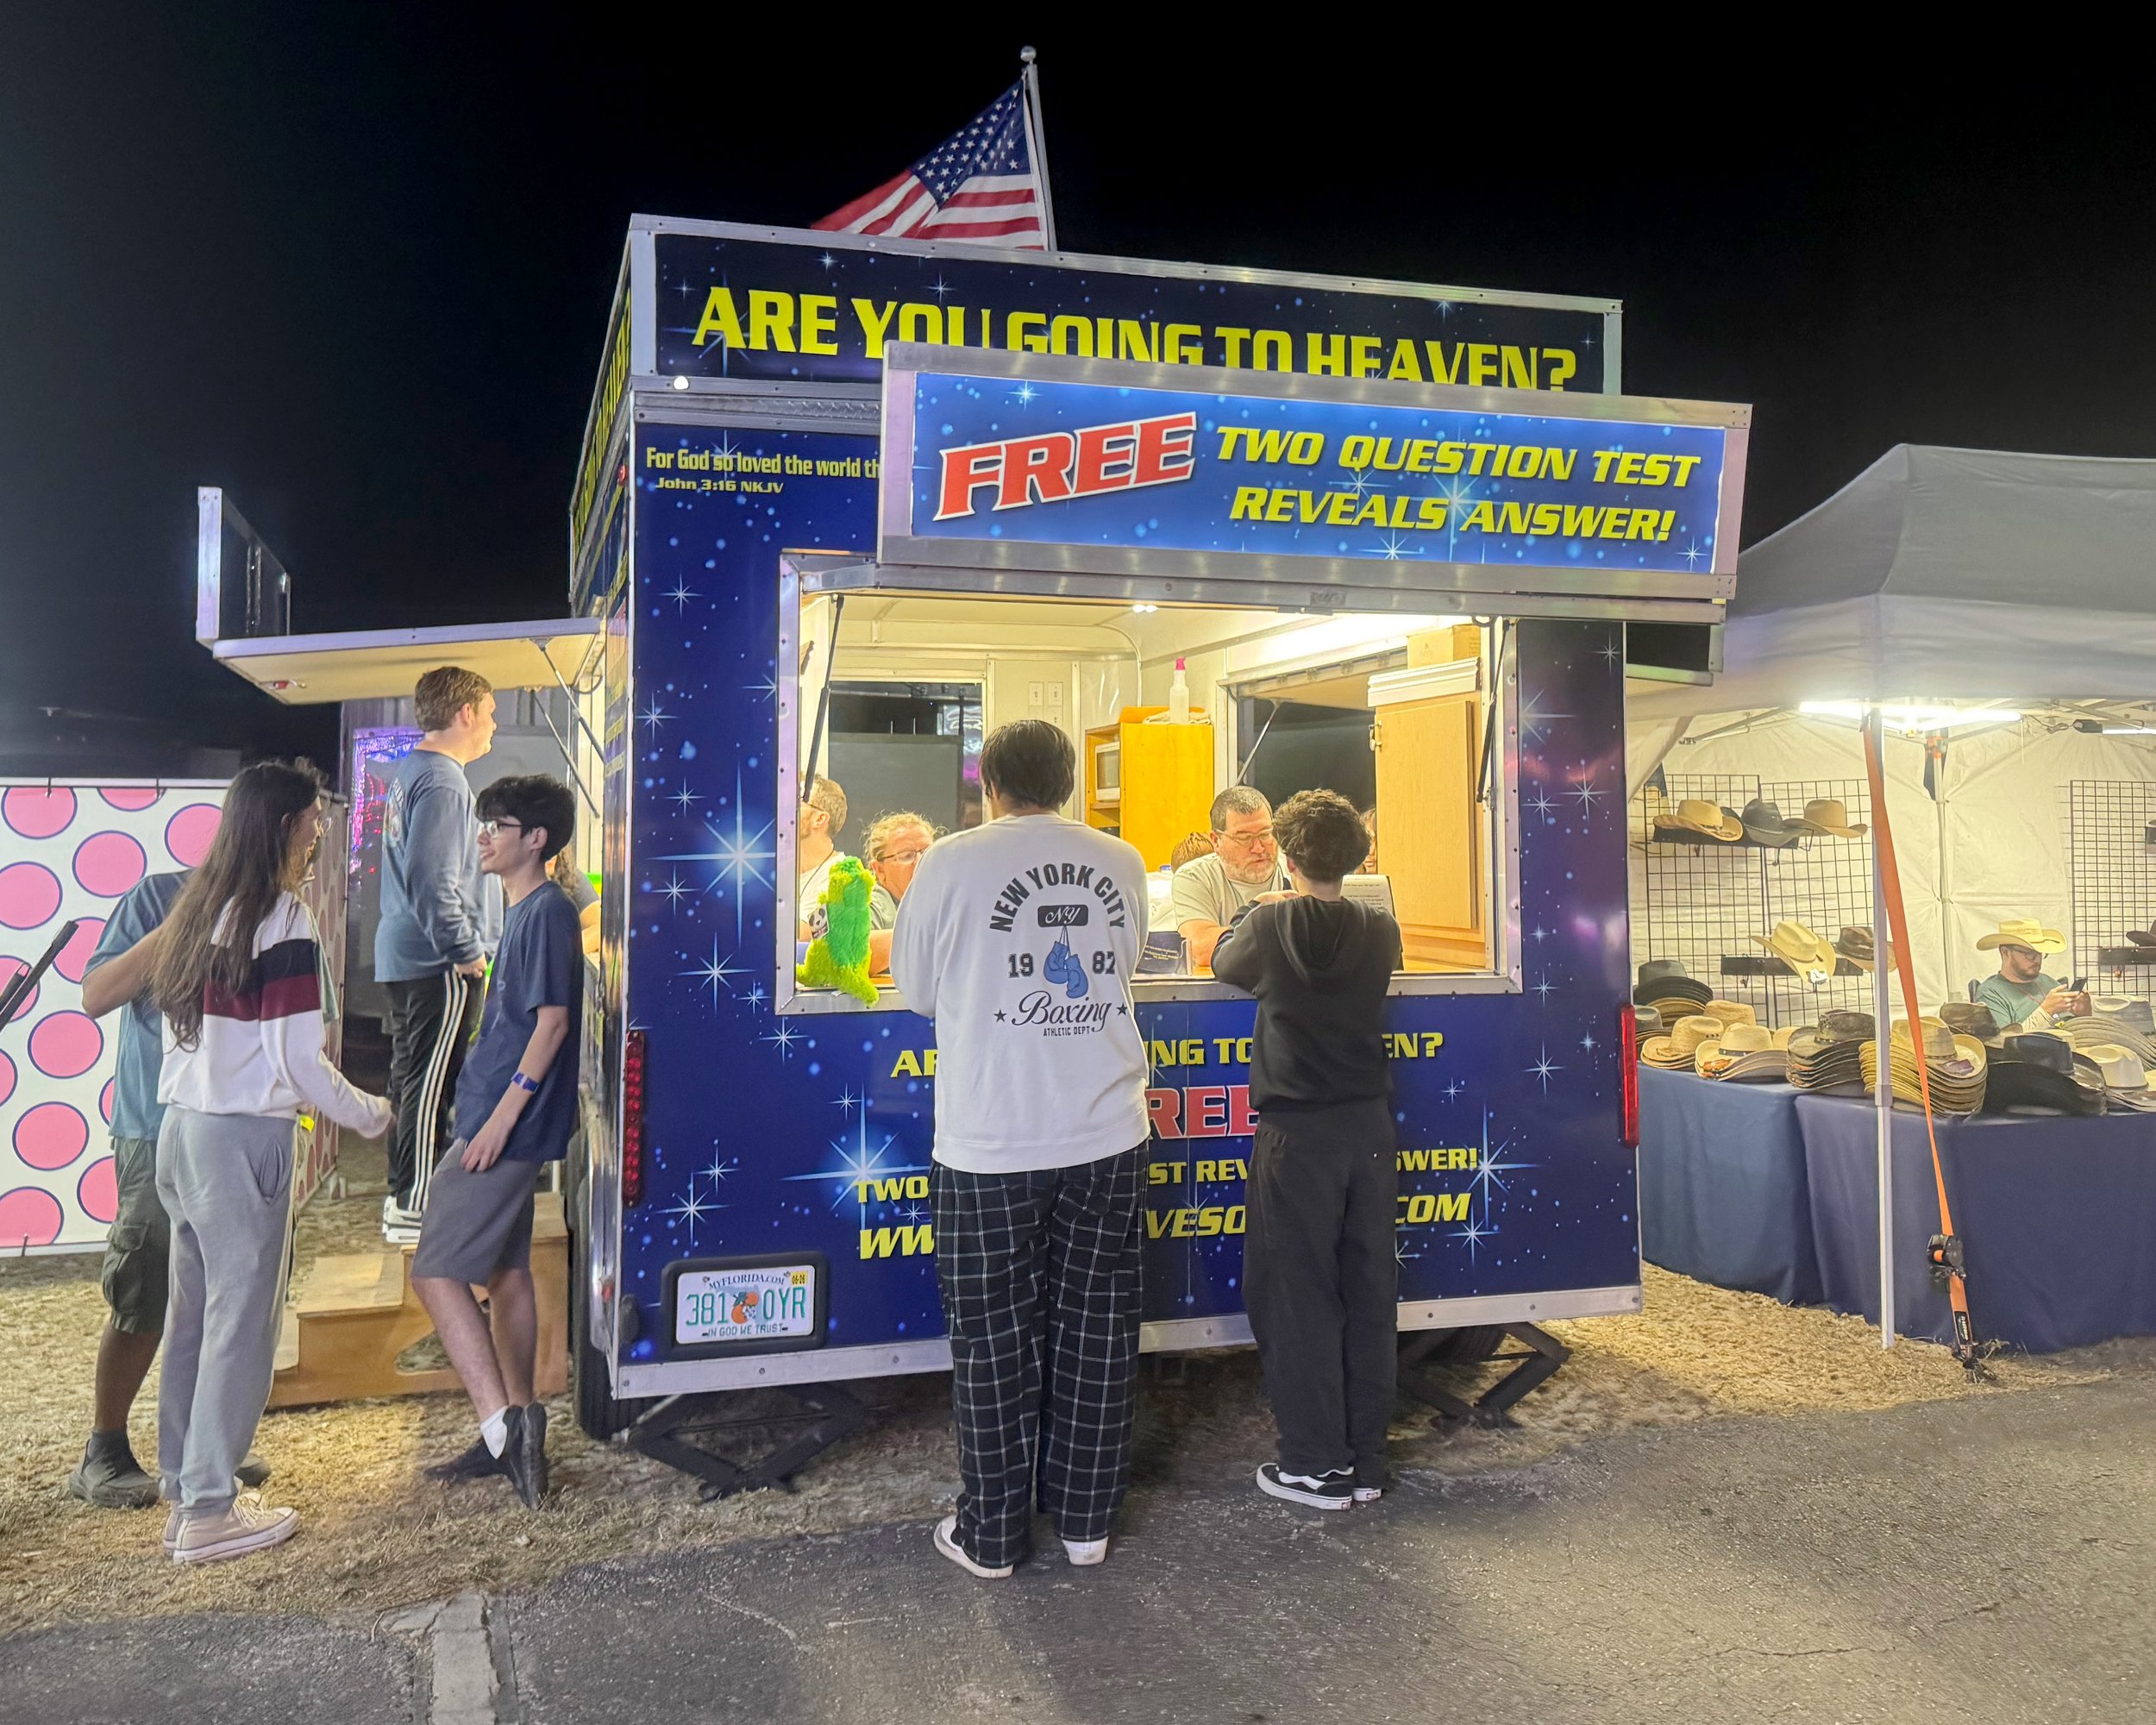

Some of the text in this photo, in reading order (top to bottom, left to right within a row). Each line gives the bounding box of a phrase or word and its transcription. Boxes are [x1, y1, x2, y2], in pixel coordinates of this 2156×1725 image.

[693, 285, 1577, 392] ARE YOU GOING TO HEAVEN?
[647, 447, 674, 469] For
[677, 448, 710, 472] God
[713, 455, 734, 473] so
[737, 451, 781, 475] loved
[785, 455, 813, 476] the
[816, 457, 862, 478] world
[932, 411, 1197, 522] FREE
[1216, 425, 1702, 489] TWO QUESTION TEST
[655, 477, 784, 493] John 3:16 NKJV
[1229, 486, 1676, 542] REVEALS ANSWER!
[989, 862, 1125, 932] NEW YORK CITY
[1007, 952, 1034, 978] 19
[1011, 990, 1113, 1032] Boxing
[1043, 1026, 1072, 1037] ATHLETIC
[854, 1176, 929, 1203] TWO
[686, 1292, 729, 1327] 381
[708, 1323, 783, 1337] IN GOD WE TRUST
